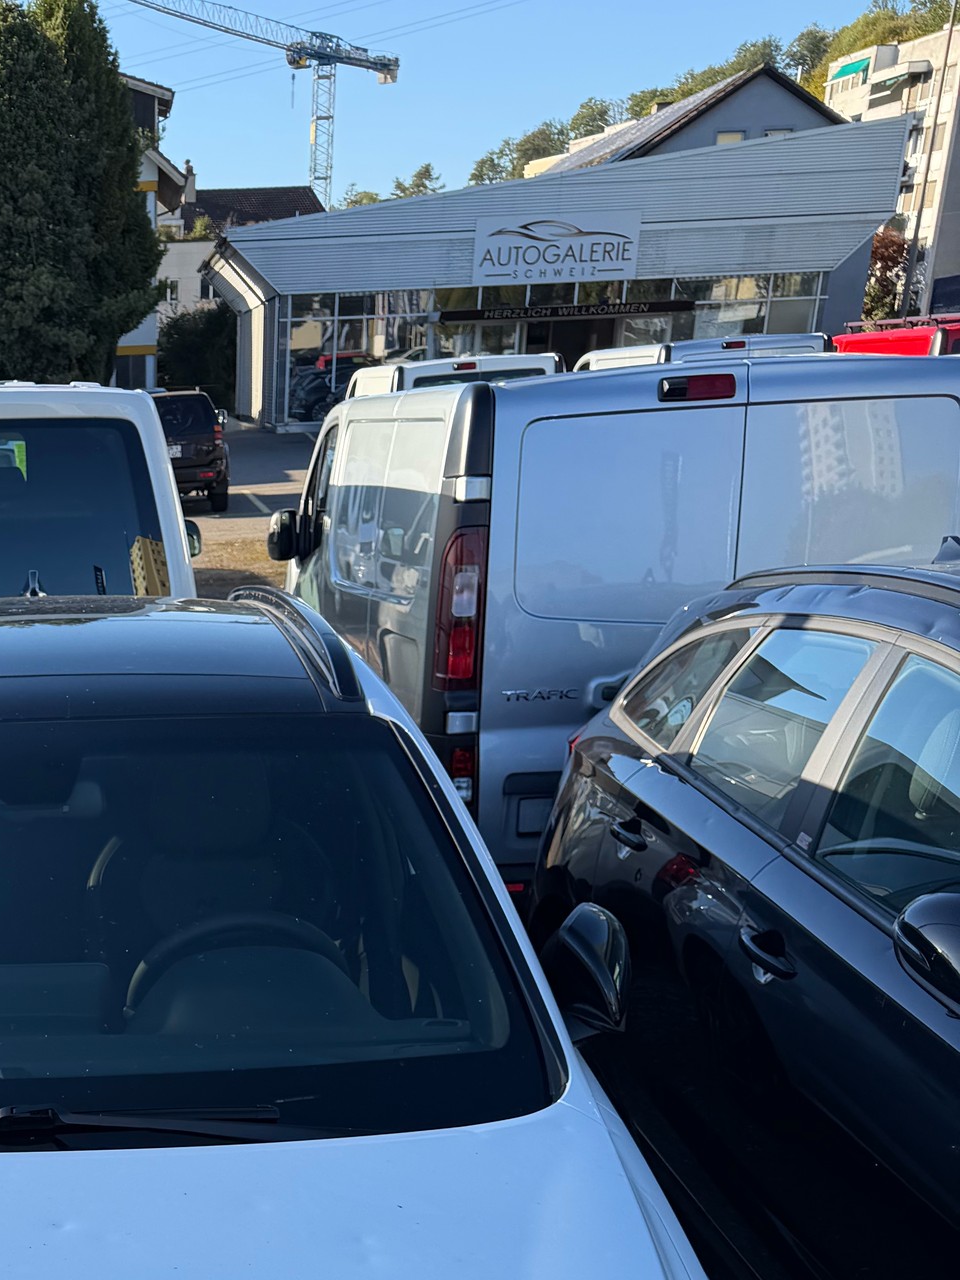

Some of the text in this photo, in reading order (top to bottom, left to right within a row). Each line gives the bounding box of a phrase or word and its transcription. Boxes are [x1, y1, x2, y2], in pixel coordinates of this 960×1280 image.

[479, 241, 634, 268] AUTOGALERIE
[512, 266, 597, 279] SCHWEIZ
[483, 303, 649, 319] HERZLICH WILLKOMMEN
[501, 688, 579, 702] TRAFIC
